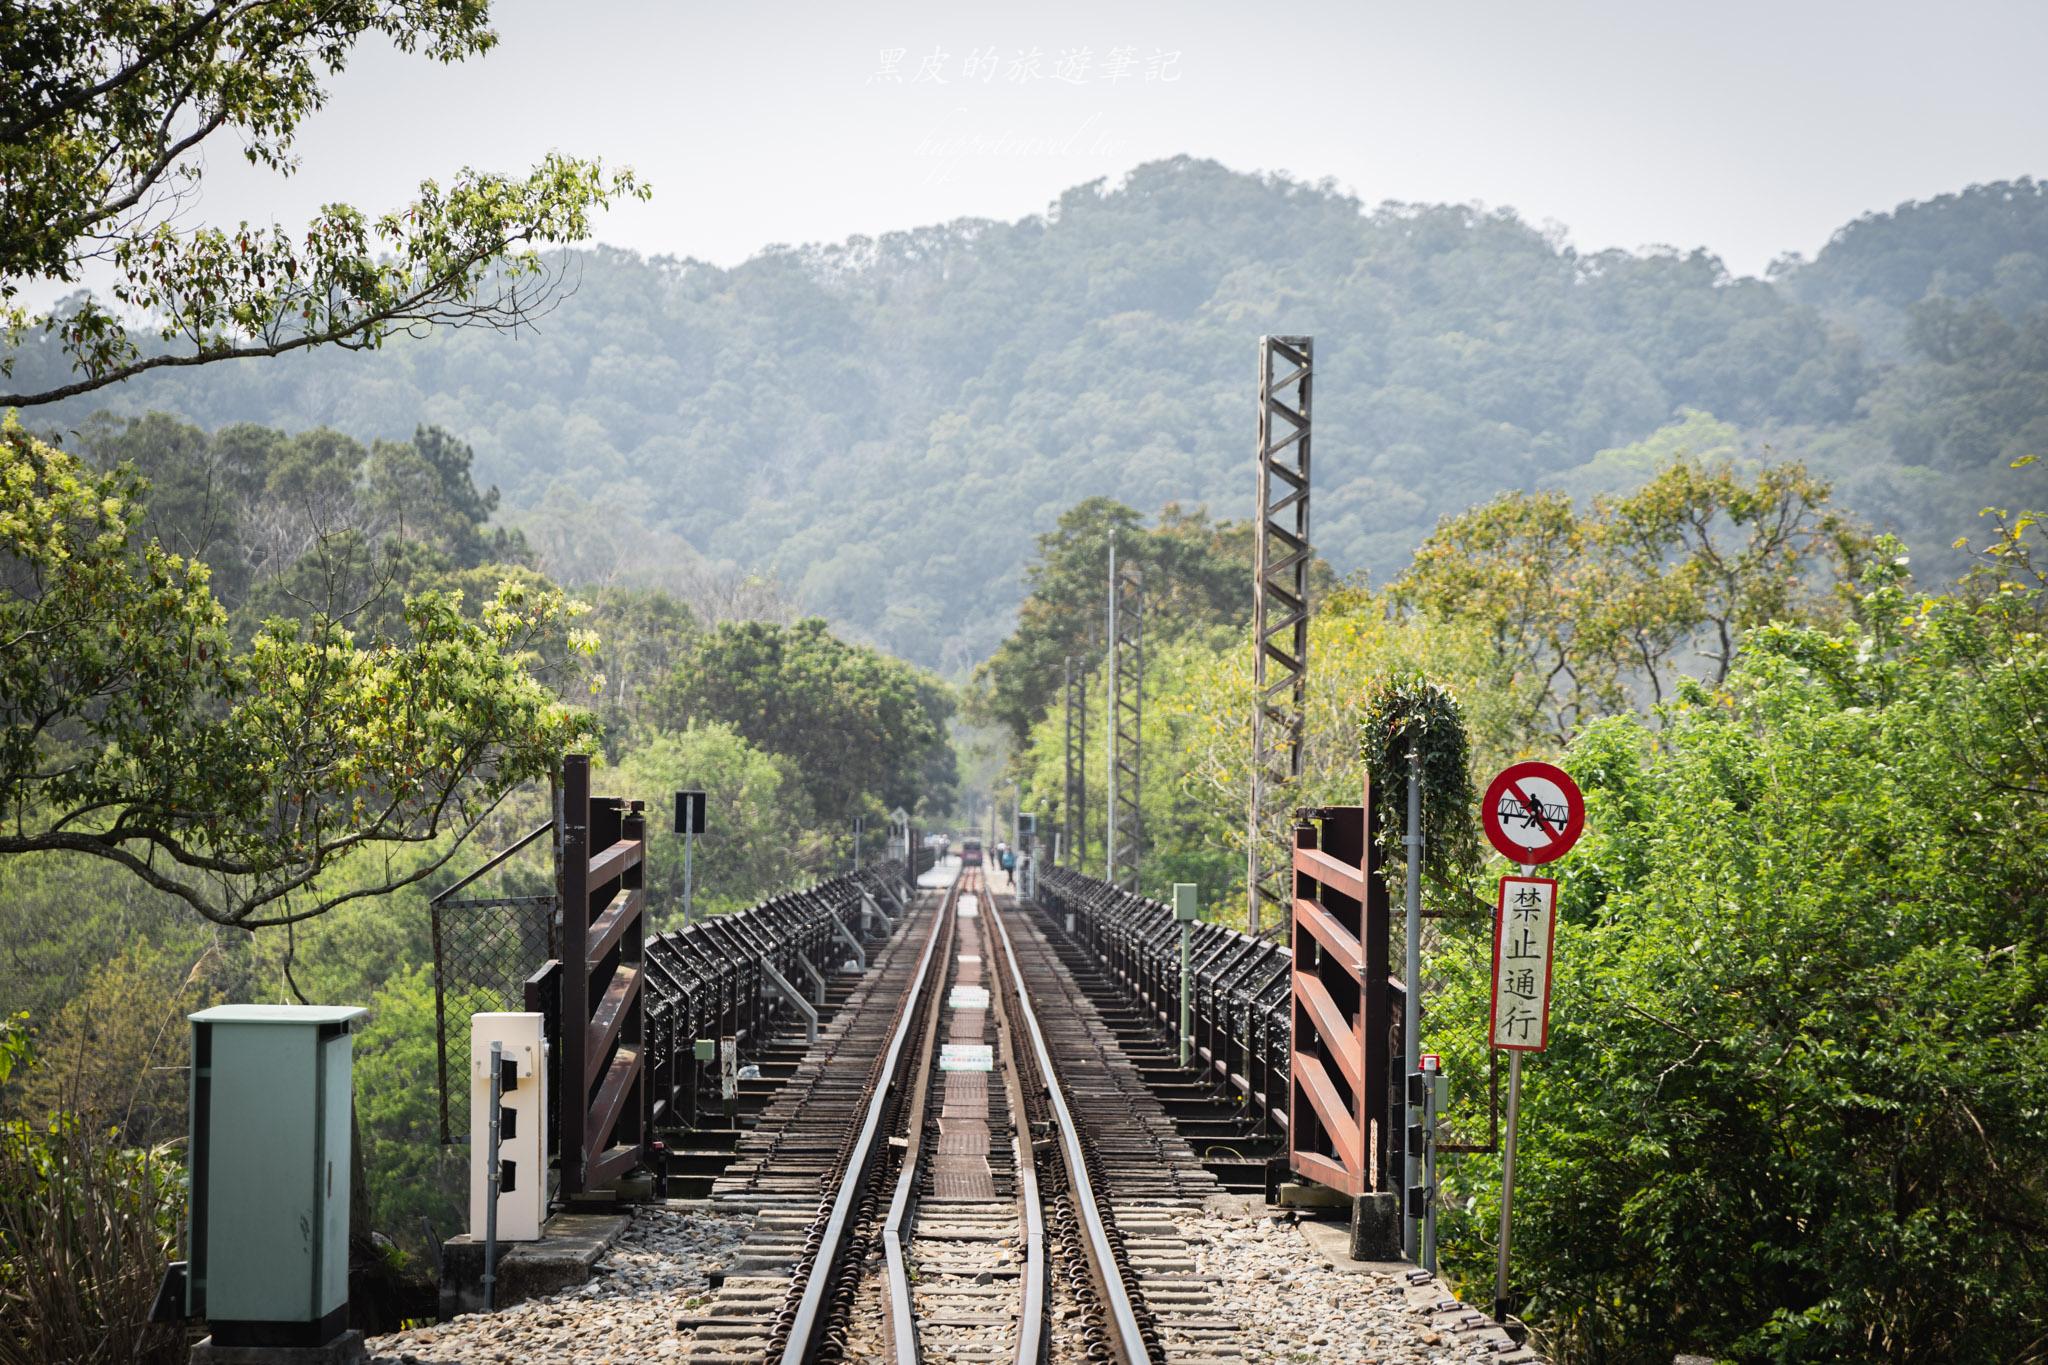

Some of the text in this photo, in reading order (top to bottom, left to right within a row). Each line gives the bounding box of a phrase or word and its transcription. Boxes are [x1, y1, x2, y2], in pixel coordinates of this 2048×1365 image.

[1501, 887, 1542, 1040] 禁止通行
[725, 1061, 734, 1077] 2
